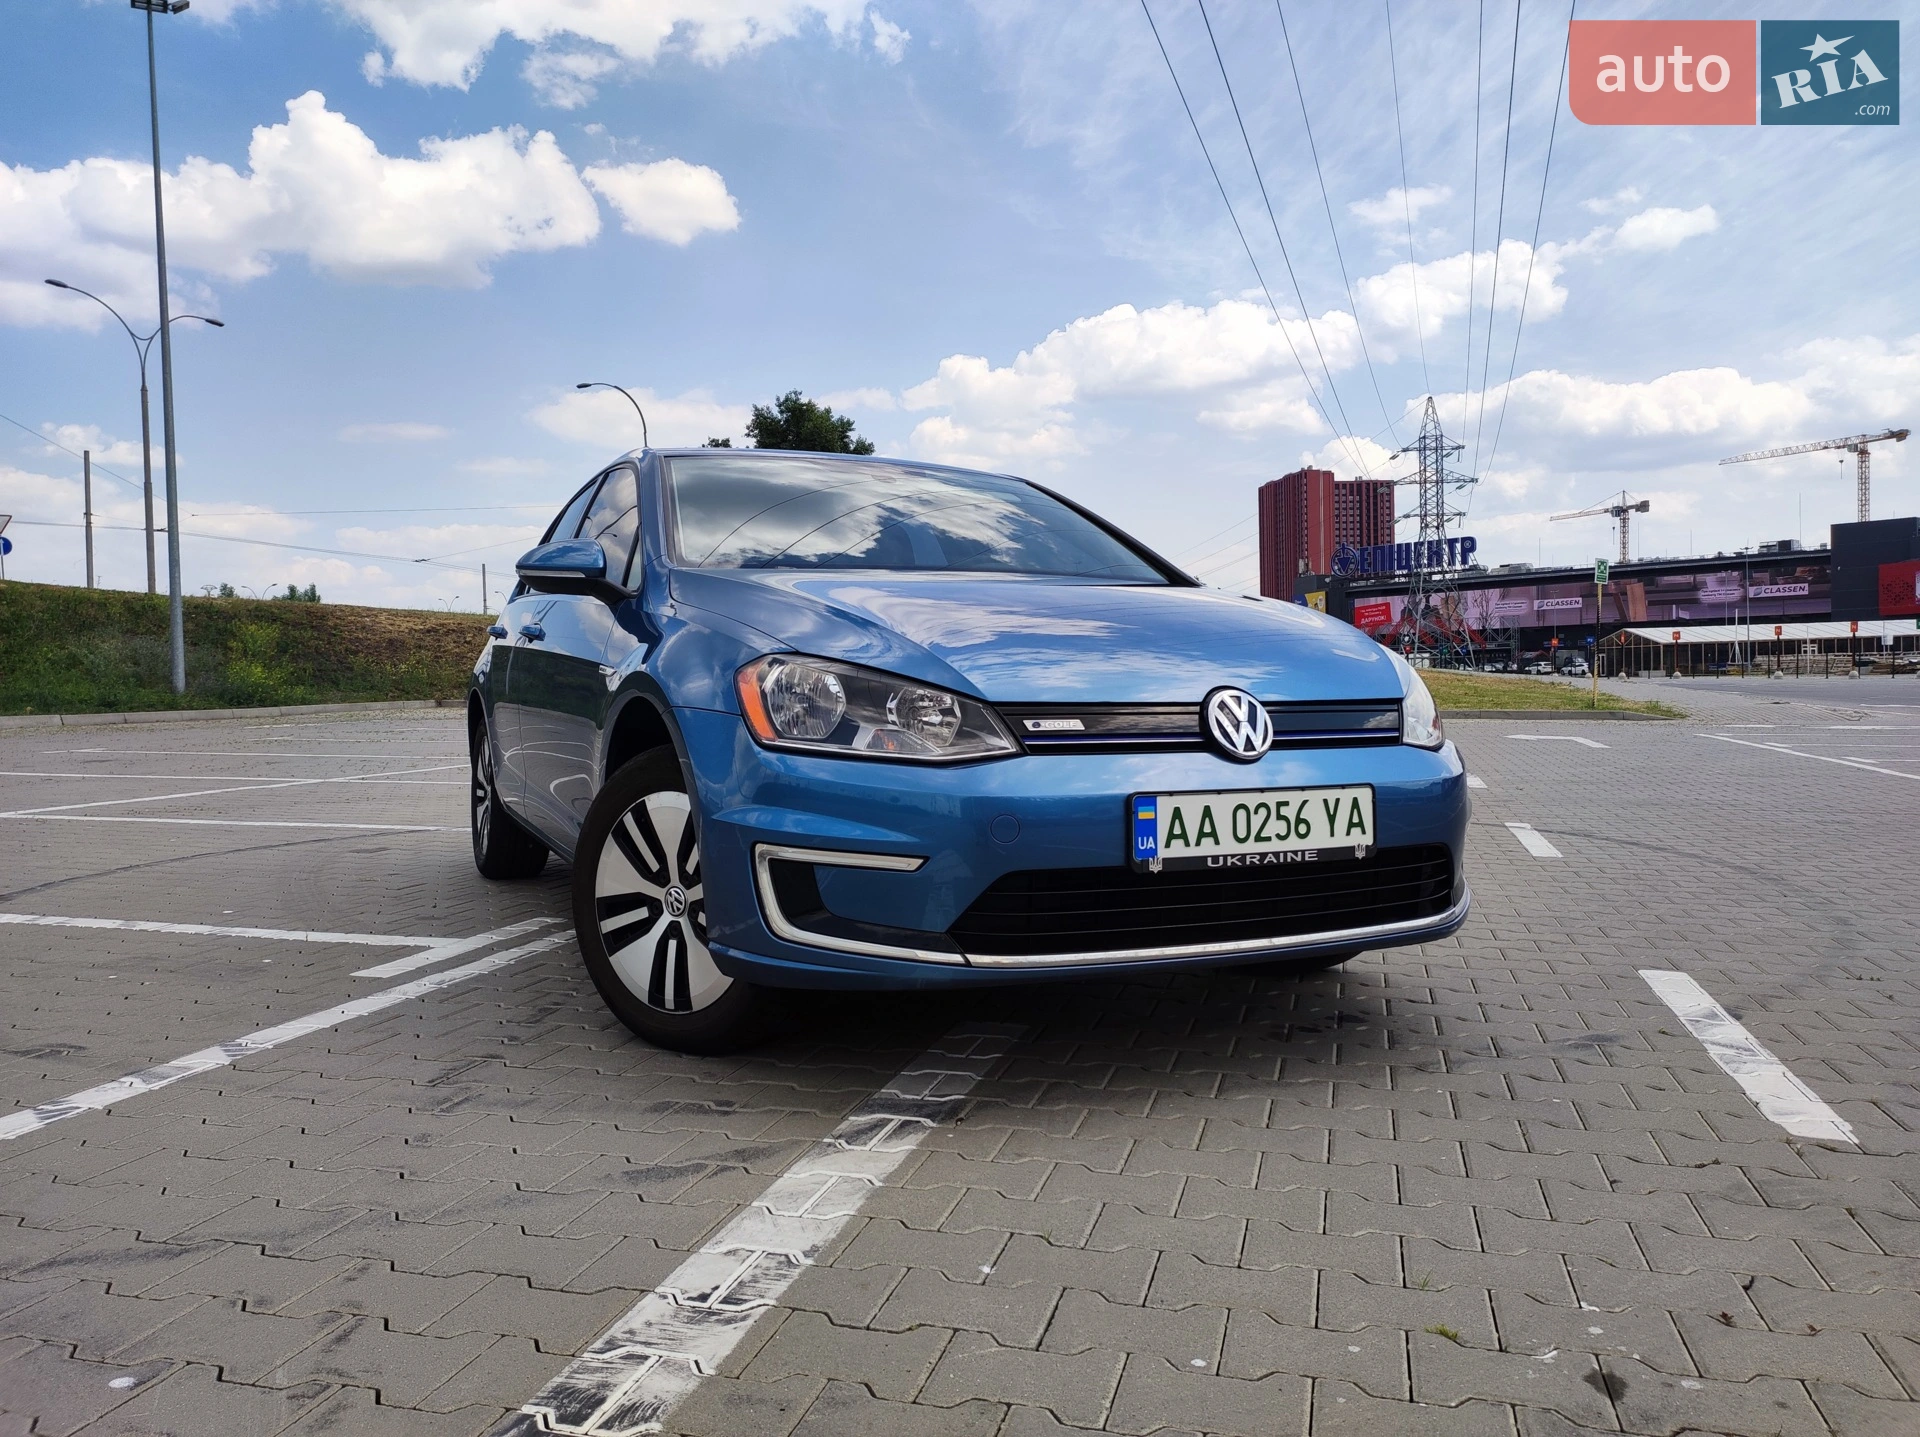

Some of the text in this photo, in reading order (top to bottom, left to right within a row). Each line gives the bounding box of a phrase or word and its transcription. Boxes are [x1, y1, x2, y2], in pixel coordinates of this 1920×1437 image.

[1164, 796, 1367, 849] AA 0256 YA
[1138, 835, 1156, 850] UA
[1206, 850, 1320, 868] UKRAINE
